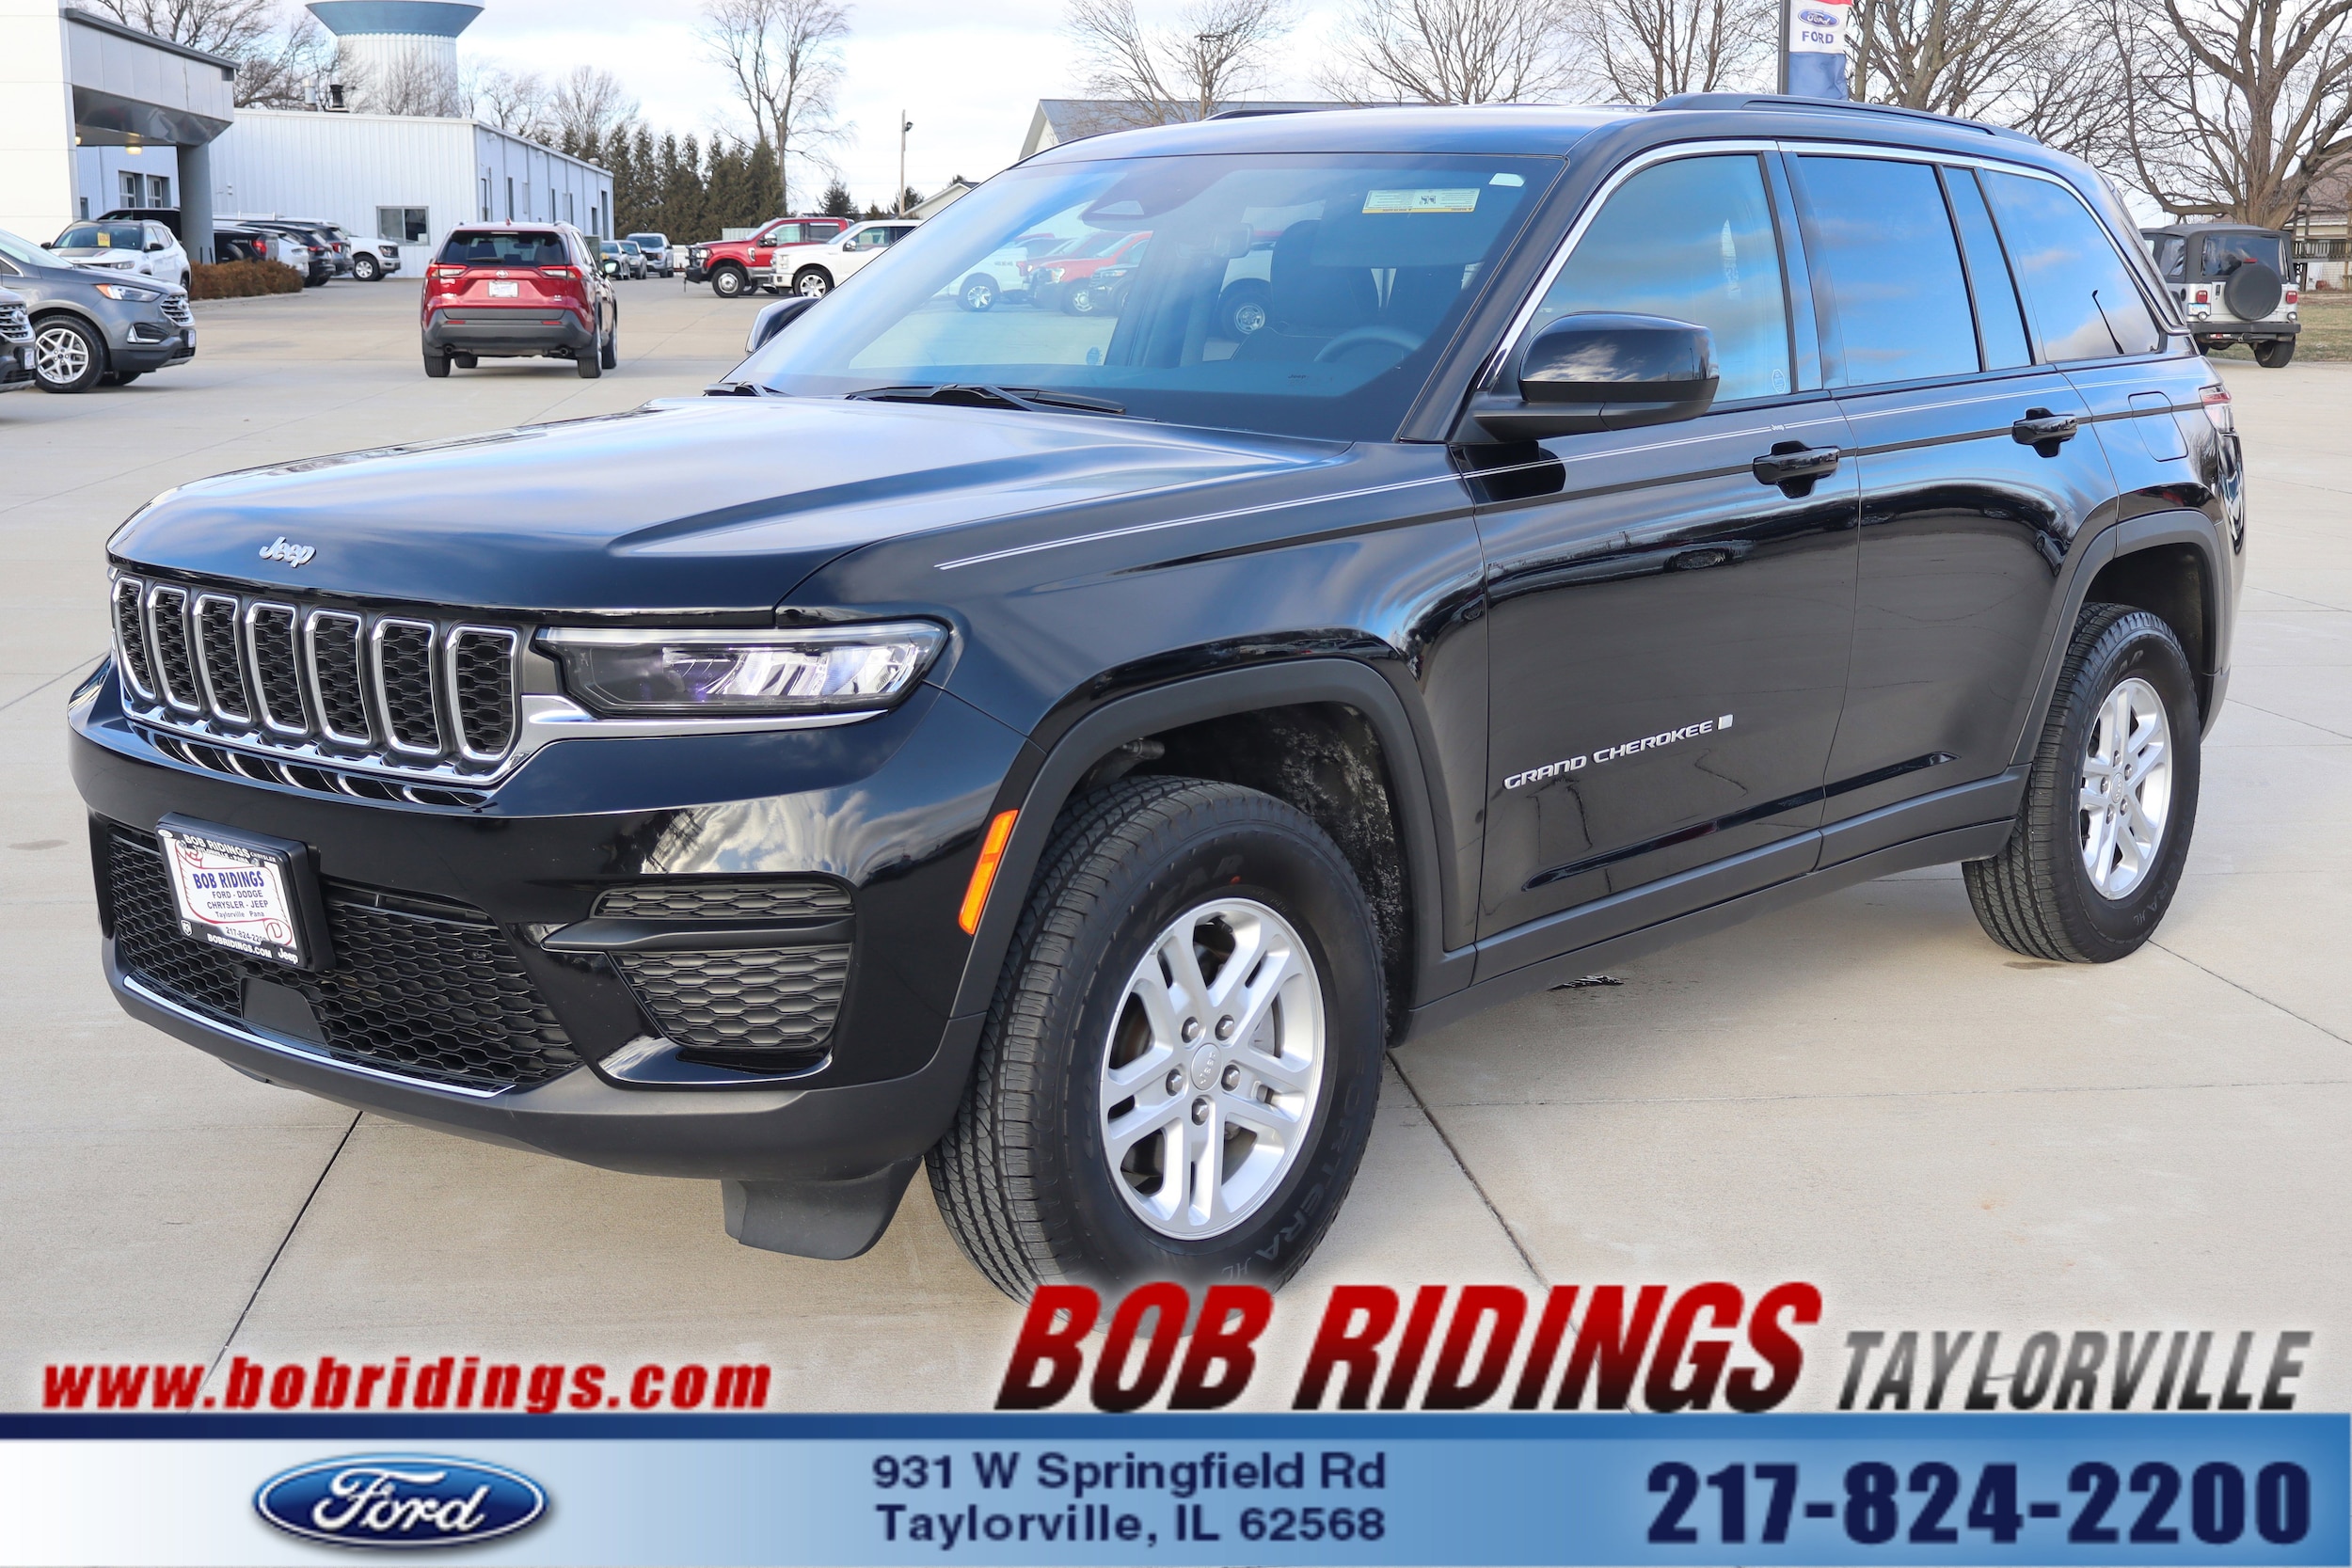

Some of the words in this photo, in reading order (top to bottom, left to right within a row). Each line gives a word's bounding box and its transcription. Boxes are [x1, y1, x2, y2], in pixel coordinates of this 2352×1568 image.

[1802, 30, 1835, 44] FORD
[258, 536, 317, 569] Jeep
[1503, 754, 1587, 790] GRAND
[1593, 720, 1713, 765] CHEROKEE
[183, 833, 207, 847] BOB
[206, 839, 252, 859] RIDINGS
[192, 872, 218, 890] BOB
[218, 870, 265, 889] RIDINGS
[212, 890, 231, 899] FORD
[237, 890, 263, 898] DODGE
[207, 900, 246, 910] CHRYSLER
[250, 899, 269, 909] JEEP
[215, 911, 246, 919] Taylorville
[206, 933, 273, 958] BOBRIDINGS.COM
[278, 947, 299, 965] Jeep
